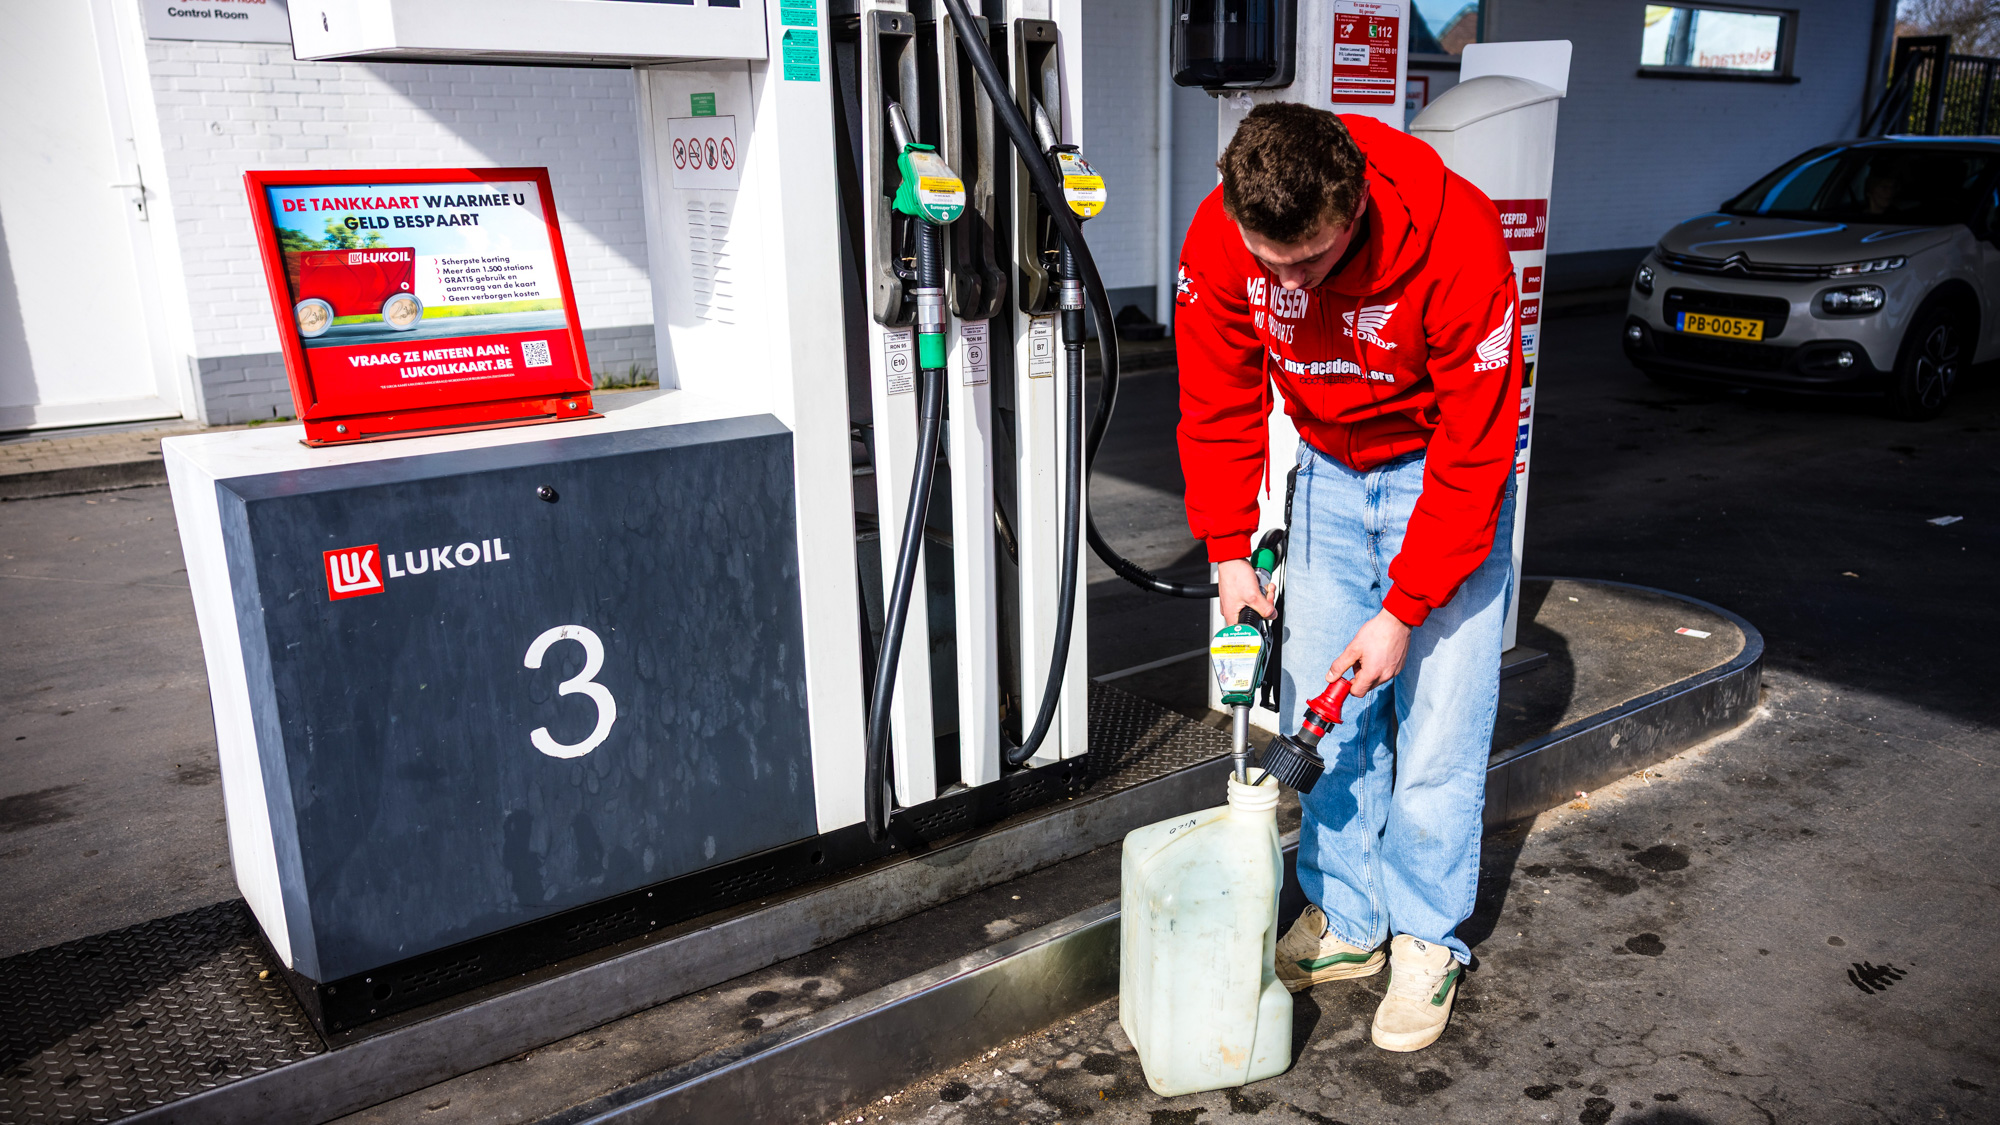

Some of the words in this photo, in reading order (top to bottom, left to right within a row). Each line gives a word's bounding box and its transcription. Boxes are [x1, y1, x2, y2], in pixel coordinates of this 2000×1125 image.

[167, 7, 211, 18] Control
[214, 9, 249, 20] Room
[1378, 26, 1392, 38] 112
[282, 198, 305, 212] DE
[310, 196, 419, 211] TANKKAART
[423, 193, 510, 208] WAARMEE
[513, 193, 525, 206] U
[344, 216, 389, 230] GELD
[394, 213, 479, 229] BESPAART
[1500, 213, 1527, 225] CCEPTED
[1514, 228, 1535, 238] OUTSIDE
[363, 252, 410, 263] LUKOIL
[442, 258, 480, 266] Scherpste
[481, 256, 510, 264] korting
[465, 266, 481, 274] dan
[483, 265, 502, 273] 1.500
[503, 264, 533, 272] stations
[444, 276, 474, 284] GRATIS
[475, 274, 506, 284] gebruik
[446, 284, 486, 293] aanvraag
[487, 283, 502, 291] van
[514, 281, 536, 289] kaart
[472, 292, 513, 301] verborgen
[514, 290, 540, 298] kosten
[1523, 306, 1537, 314] CAPS
[1688, 315, 1758, 337] PB-005-Z
[348, 352, 401, 368] VRAAG
[403, 349, 421, 363] ZE
[422, 346, 474, 361] METEEN
[476, 344, 510, 357] AAN:
[399, 358, 514, 379] LUKOILKAART.BE
[894, 359, 905, 367] E10
[387, 538, 511, 578] LUKOIL
[523, 624, 617, 759] 3
